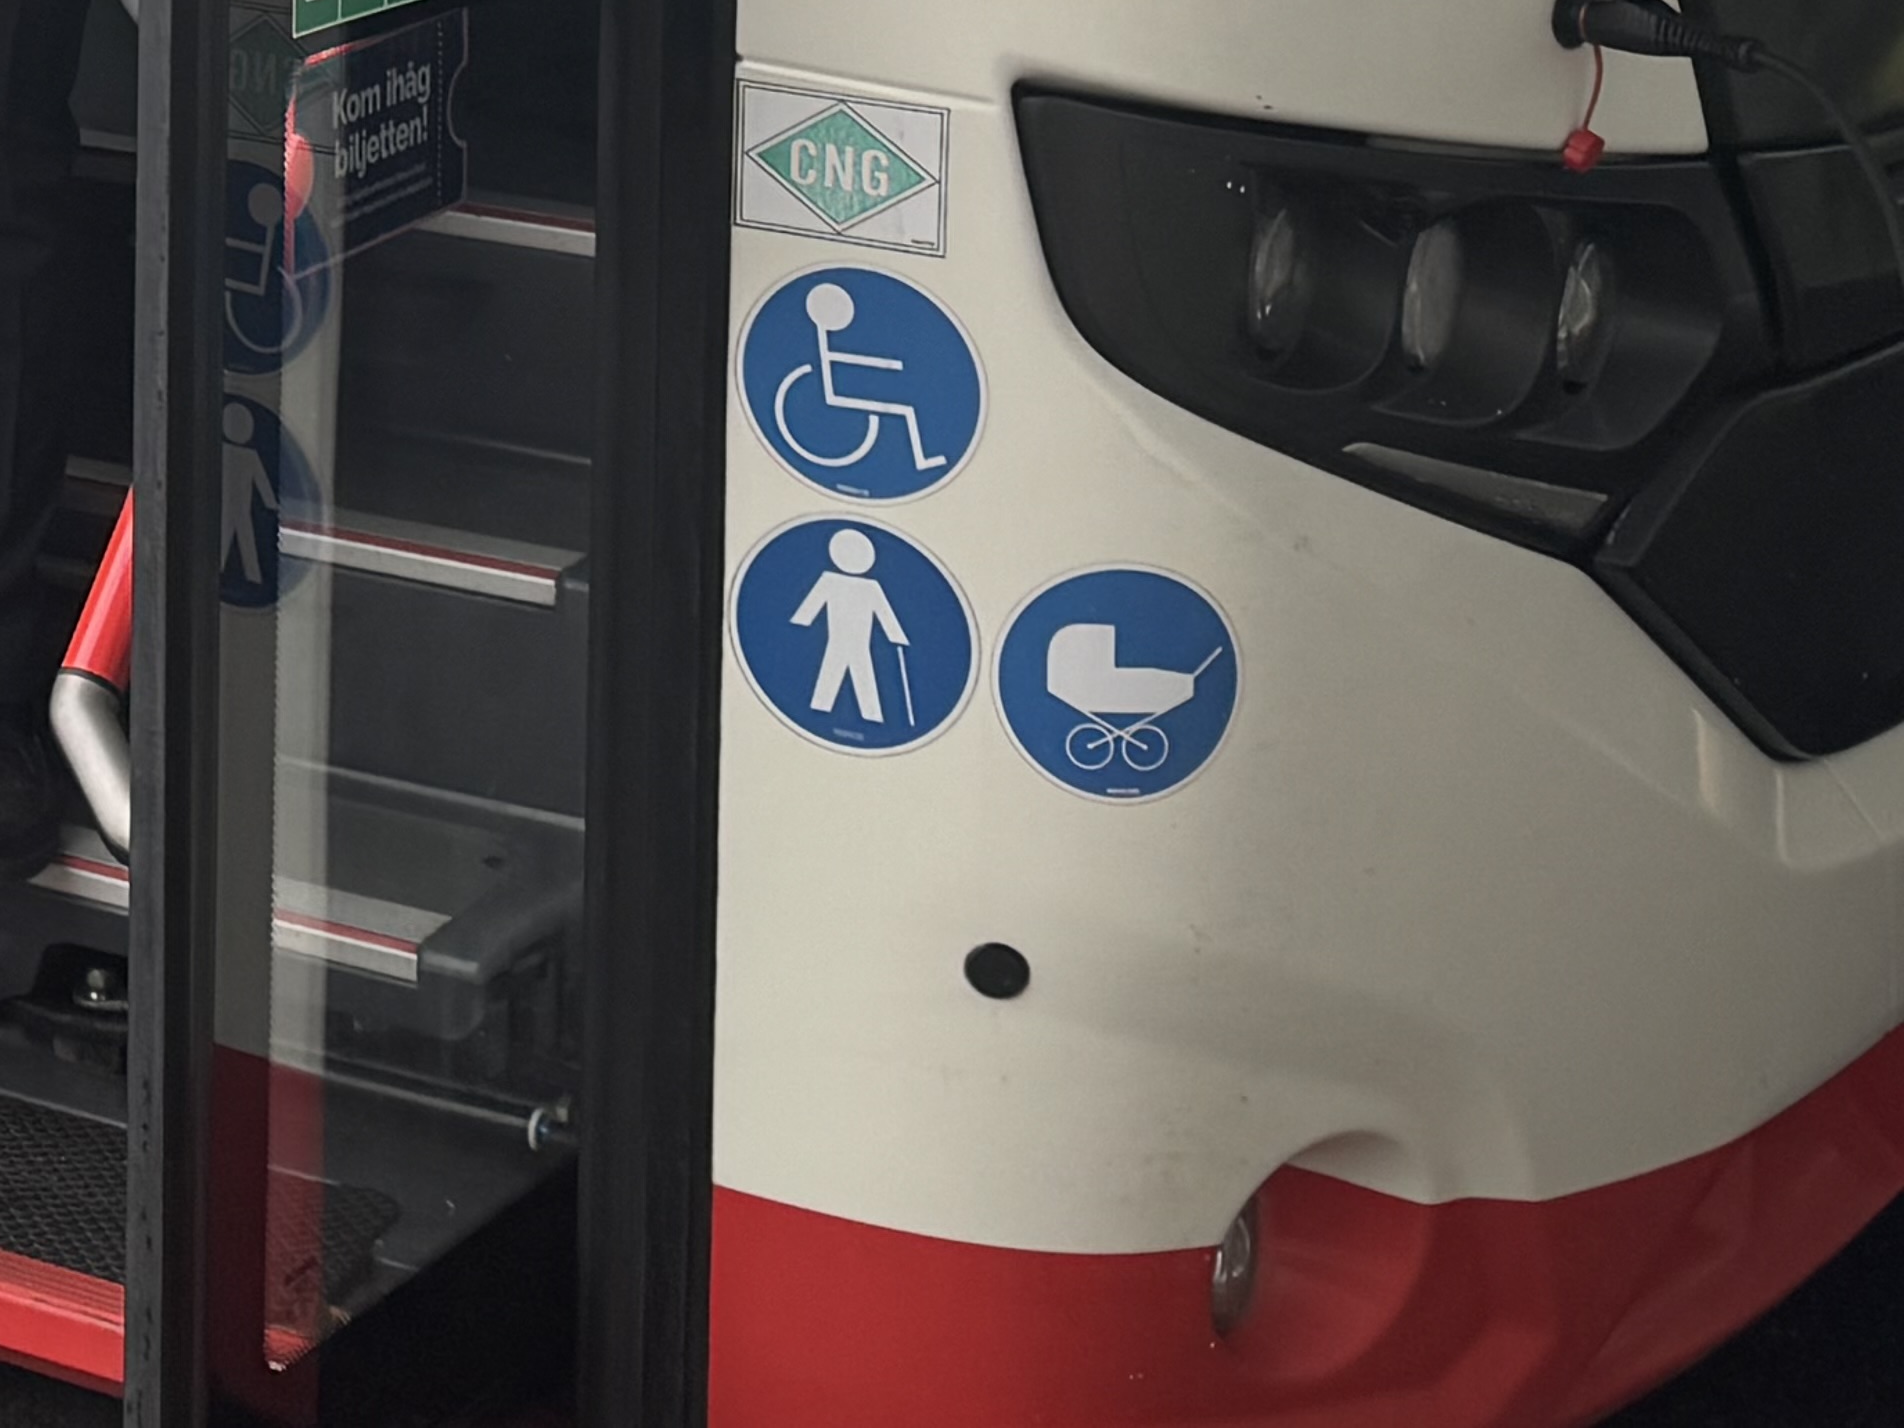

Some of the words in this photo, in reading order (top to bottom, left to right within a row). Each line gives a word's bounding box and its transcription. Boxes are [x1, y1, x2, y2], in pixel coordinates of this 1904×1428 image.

[332, 82, 381, 131] Kom
[385, 60, 432, 106] ihåg
[334, 103, 429, 180] biljetten!
[790, 138, 890, 198] CNG
